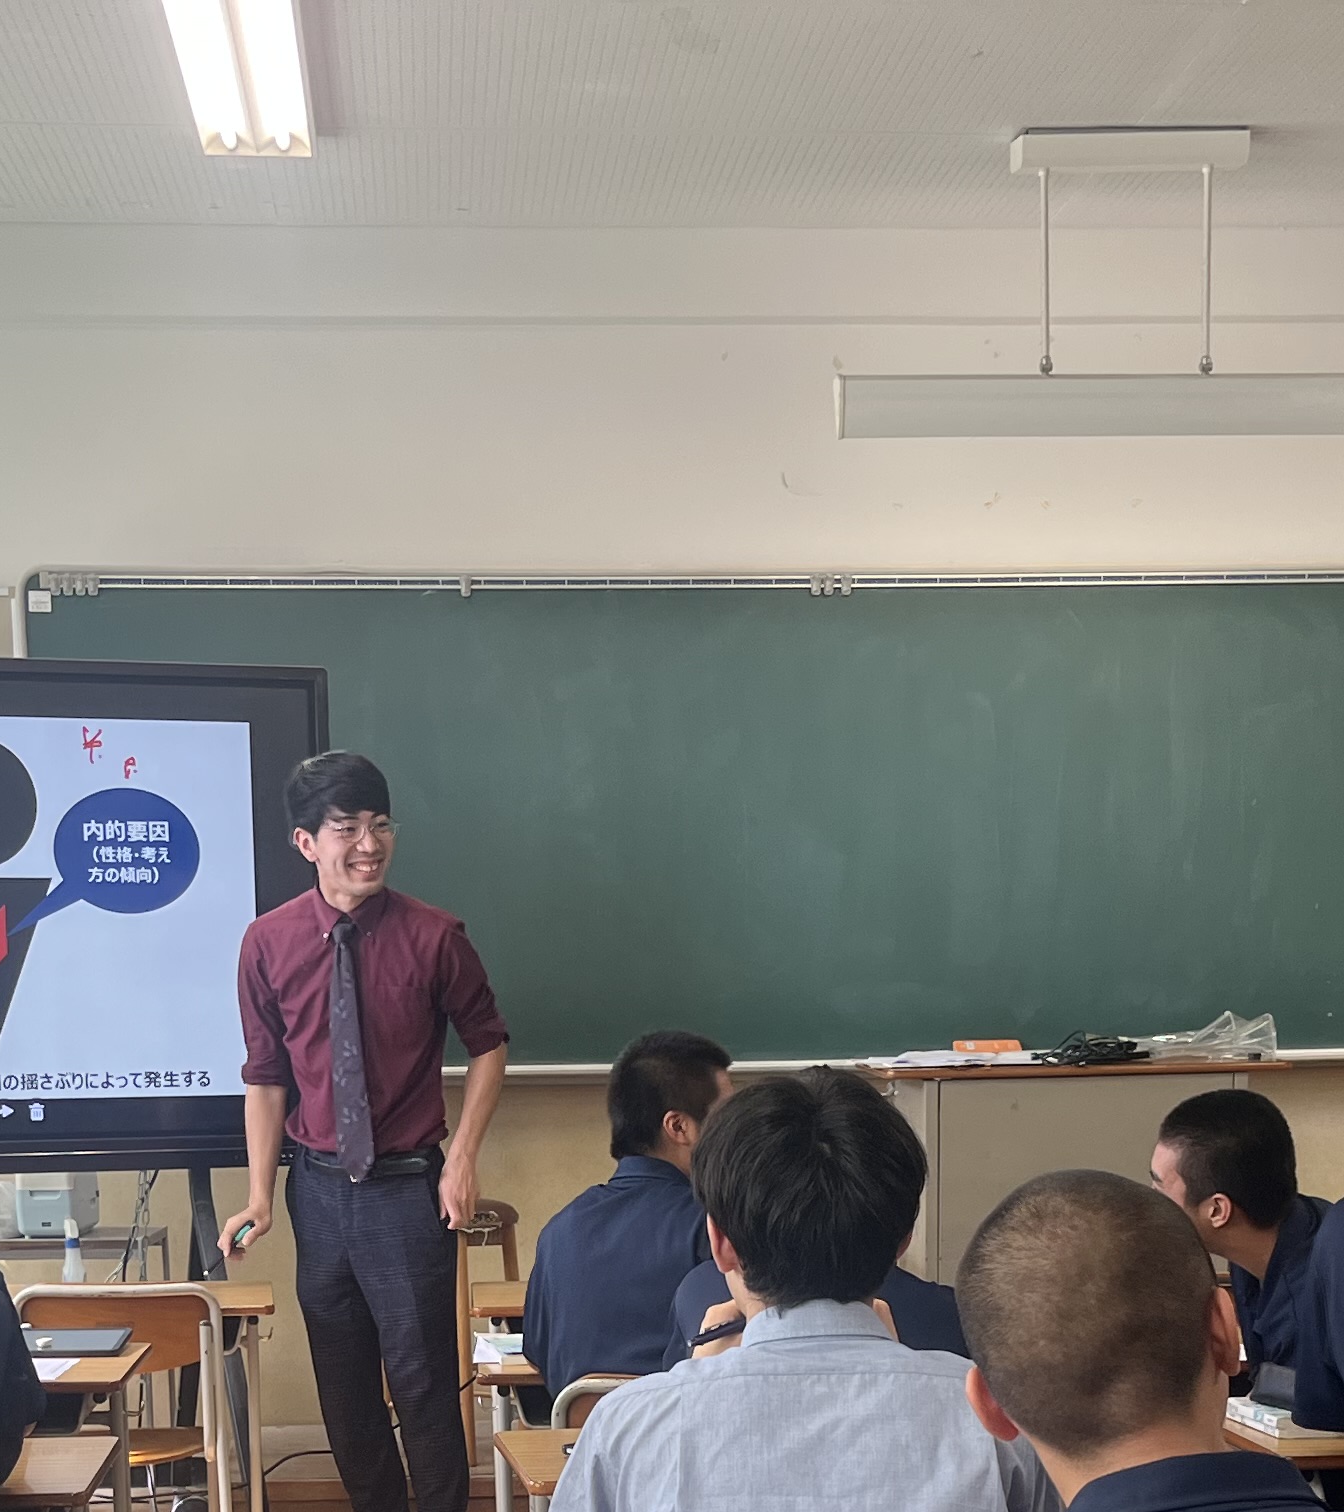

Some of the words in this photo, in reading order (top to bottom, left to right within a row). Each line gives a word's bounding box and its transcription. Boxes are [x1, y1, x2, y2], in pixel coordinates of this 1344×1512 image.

[82, 819, 170, 842] 内的要因
[92, 845, 171, 863] （性格・考え
[87, 866, 159, 884] 方の傾向）
